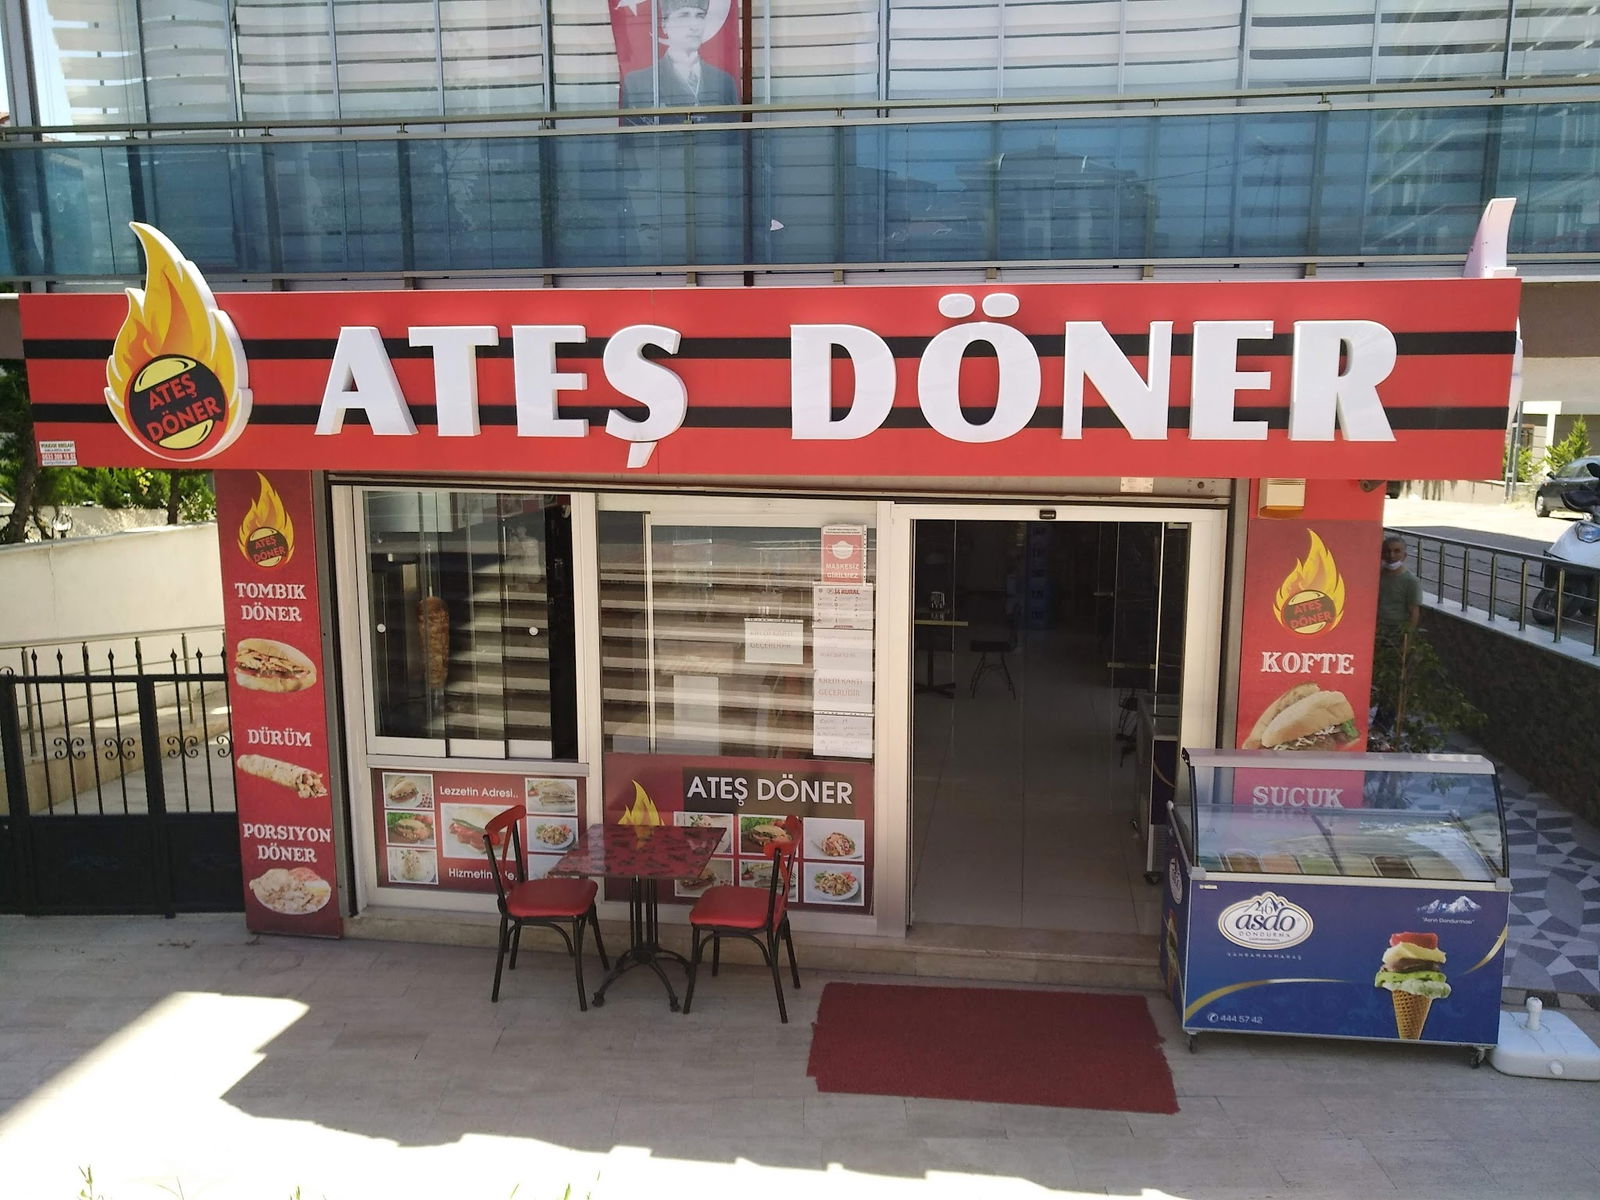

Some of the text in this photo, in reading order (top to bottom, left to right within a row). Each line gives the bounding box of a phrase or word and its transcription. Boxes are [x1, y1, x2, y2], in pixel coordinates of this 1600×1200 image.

[149, 372, 197, 411] ATEŞ
[314, 293, 1397, 470] ATEŞ DÖNER
[146, 396, 222, 442] DÖNER
[254, 535, 277, 550] ATEŞ
[253, 546, 287, 564] DÖNER
[234, 582, 307, 600] TOMBIK
[240, 602, 303, 622] DÖNER
[1293, 600, 1322, 615] ATEŞ
[1290, 611, 1333, 629] DÖNER
[1260, 652, 1354, 675] KOFTE
[247, 726, 312, 747] DÜRÜM
[440, 786, 479, 798] Lezzetin
[687, 774, 853, 806] ATEŞ DÖNER
[1252, 786, 1345, 809] SUCUK
[242, 823, 332, 843] PORSIYON
[257, 842, 317, 862] DÖNER
[1235, 907, 1296, 933] asdo
[1220, 1014, 1264, 1025] 444 57 42
